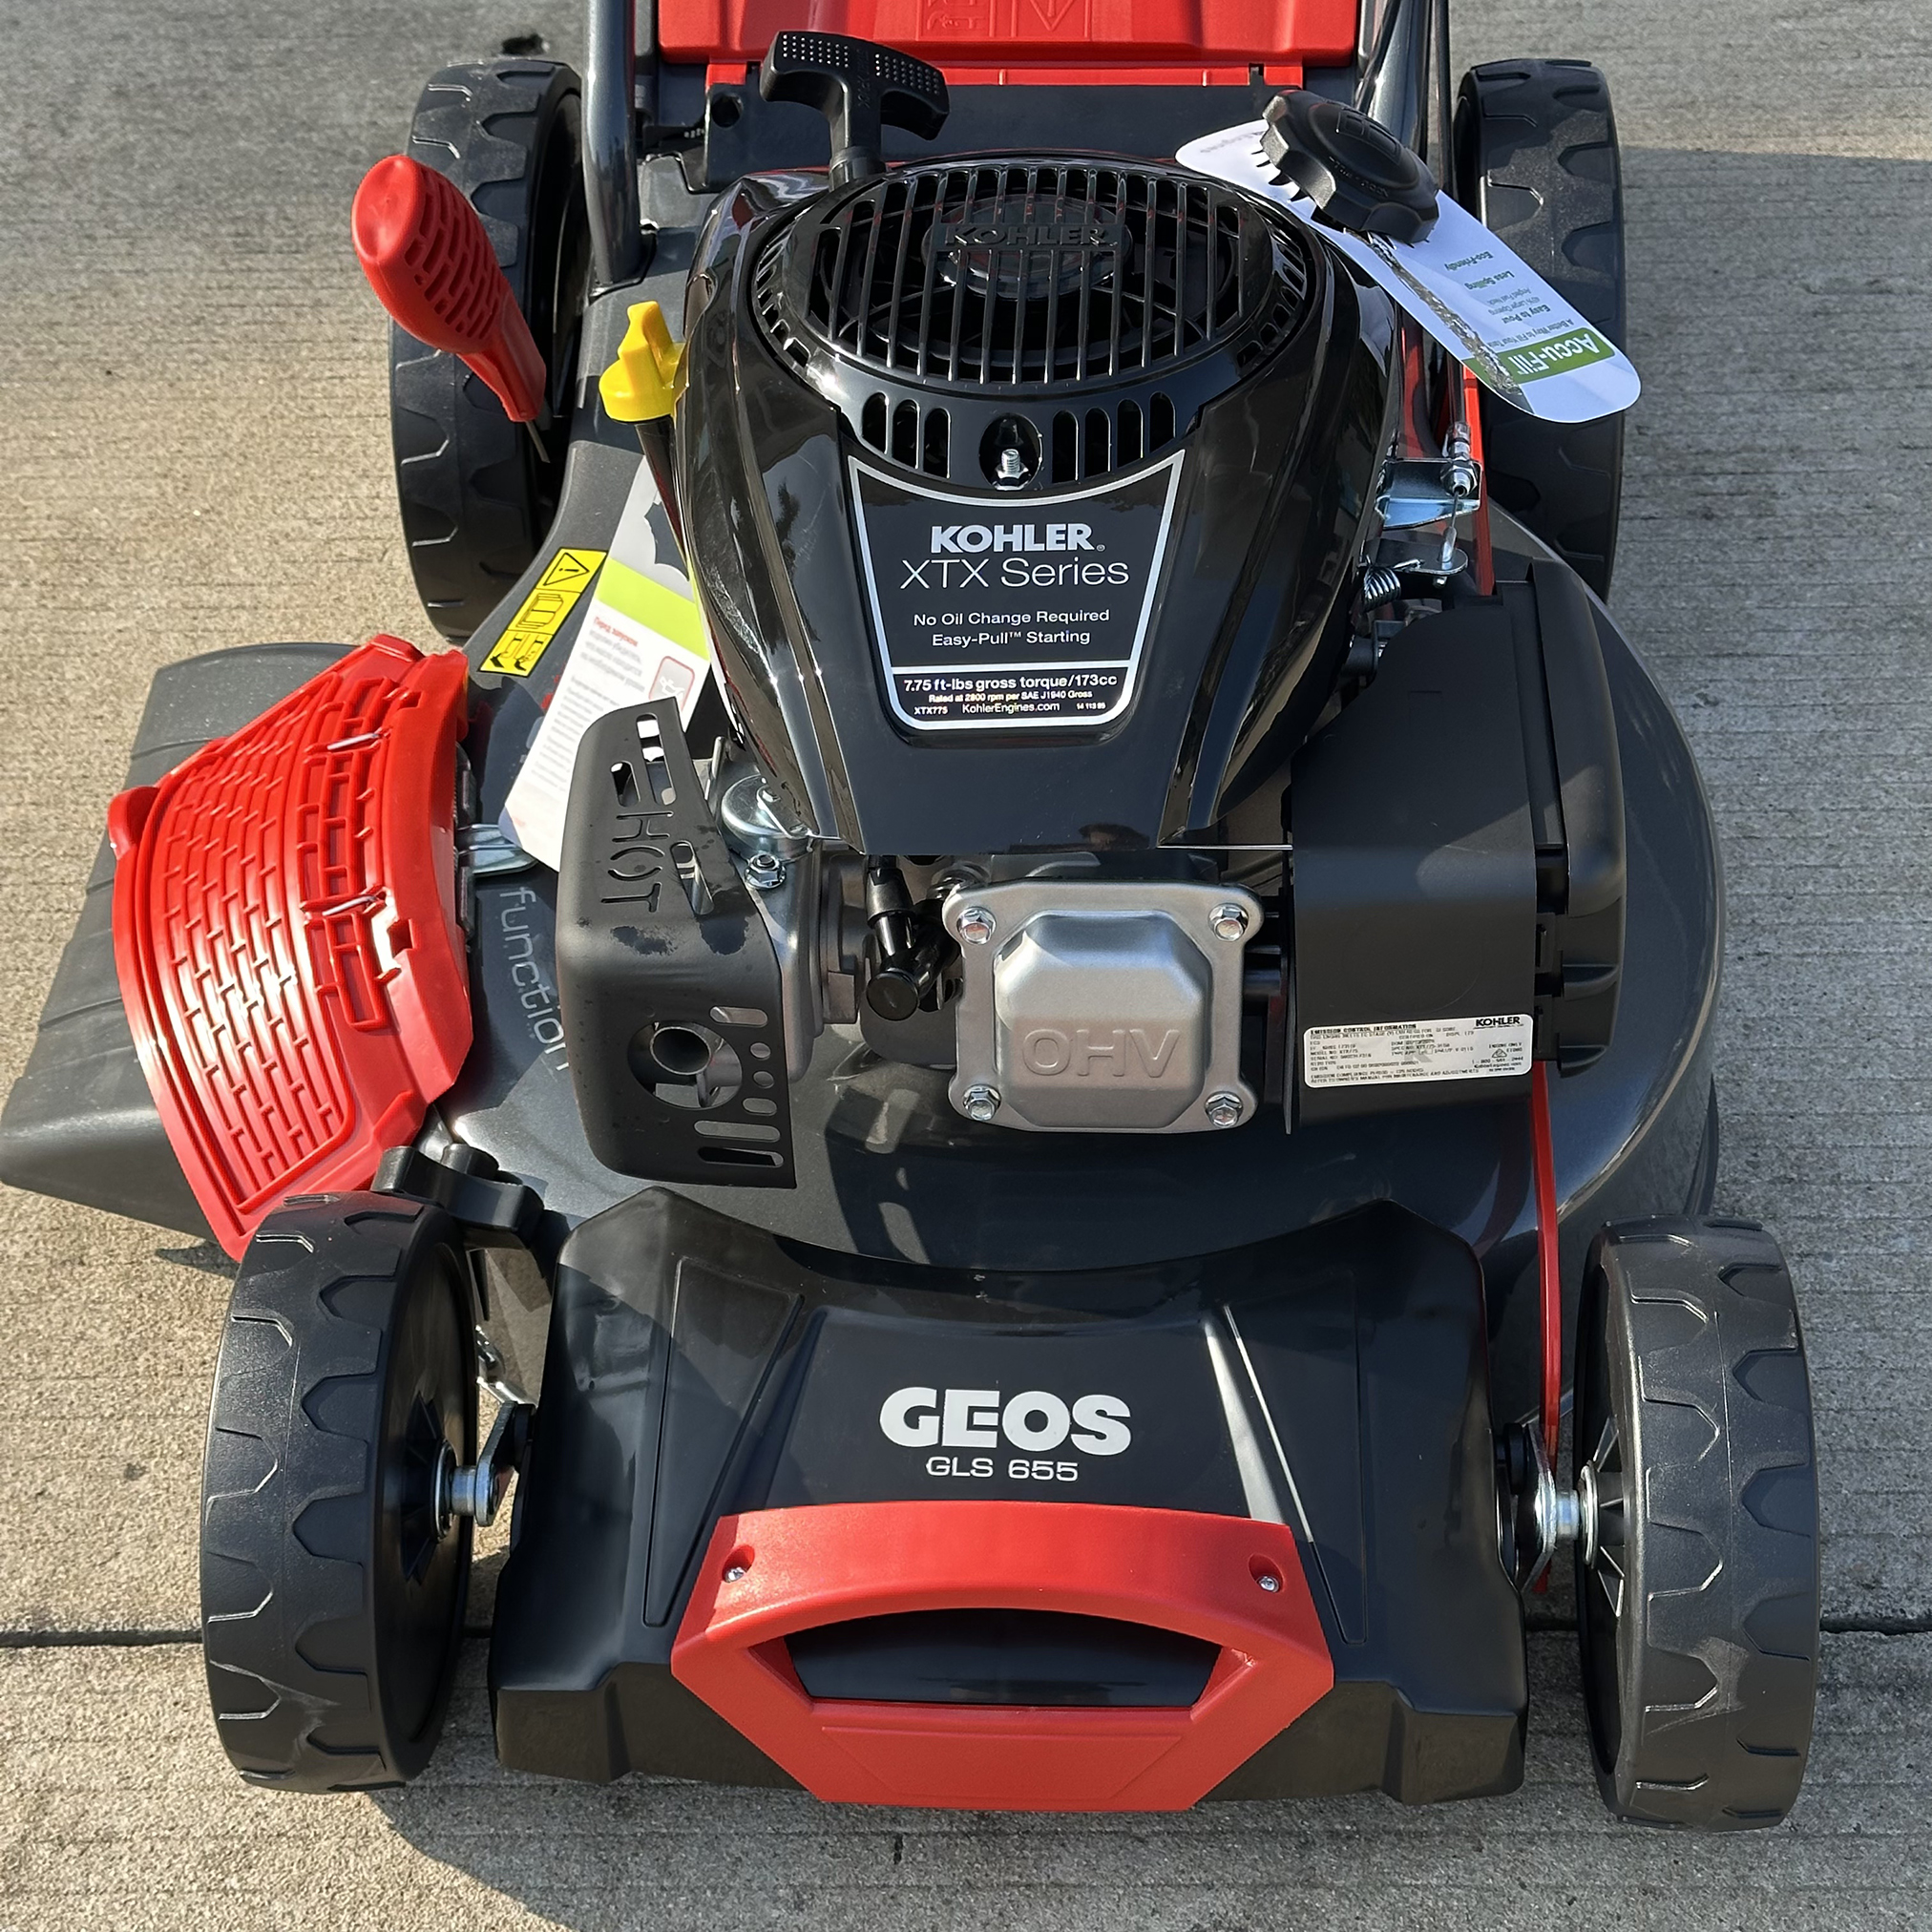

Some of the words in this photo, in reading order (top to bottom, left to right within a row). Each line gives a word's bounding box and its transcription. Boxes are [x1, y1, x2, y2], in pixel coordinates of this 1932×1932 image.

[945, 225, 1107, 246] KOHLER
[1444, 251, 1493, 272] Eco-Friendly
[1464, 277, 1496, 291] Spilling
[1494, 270, 1515, 283] Less
[1528, 304, 1550, 316] Easy
[1502, 314, 1522, 325] Pour
[1548, 320, 1568, 332] Better
[1517, 333, 1527, 343] Fill
[1534, 325, 1549, 338] Way
[1503, 336, 1518, 346] Your
[931, 523, 1095, 554] KOHLER
[900, 557, 989, 589] XTX
[1000, 556, 1130, 587] Series
[914, 614, 937, 626] No
[941, 612, 963, 625] Oil
[968, 611, 1031, 628] Change
[1036, 609, 1109, 626] Required
[1026, 630, 1090, 646] Starting
[904, 679, 932, 692] 7.75
[934, 678, 974, 690] ft-lbs
[976, 677, 1017, 692] gross
[1019, 674, 1118, 691] torque/173cc
[929, 694, 954, 703] Rated
[955, 693, 964, 703] at
[987, 693, 1004, 704] rpm
[1005, 692, 1019, 703] per
[1020, 691, 1039, 700] SAE
[1040, 690, 1066, 700] J1940
[1067, 689, 1093, 699] Gross
[914, 705, 948, 715] XTX775
[961, 703, 1060, 716] KohlerEngines.com
[600, 809, 674, 914] HOT
[1476, 1017, 1521, 1027] KOHLER
[1022, 1028, 1182, 1079] OHV
[879, 1386, 1132, 1456] GEOS
[926, 1456, 995, 1478] GLS
[1008, 1459, 1079, 1482] 655
